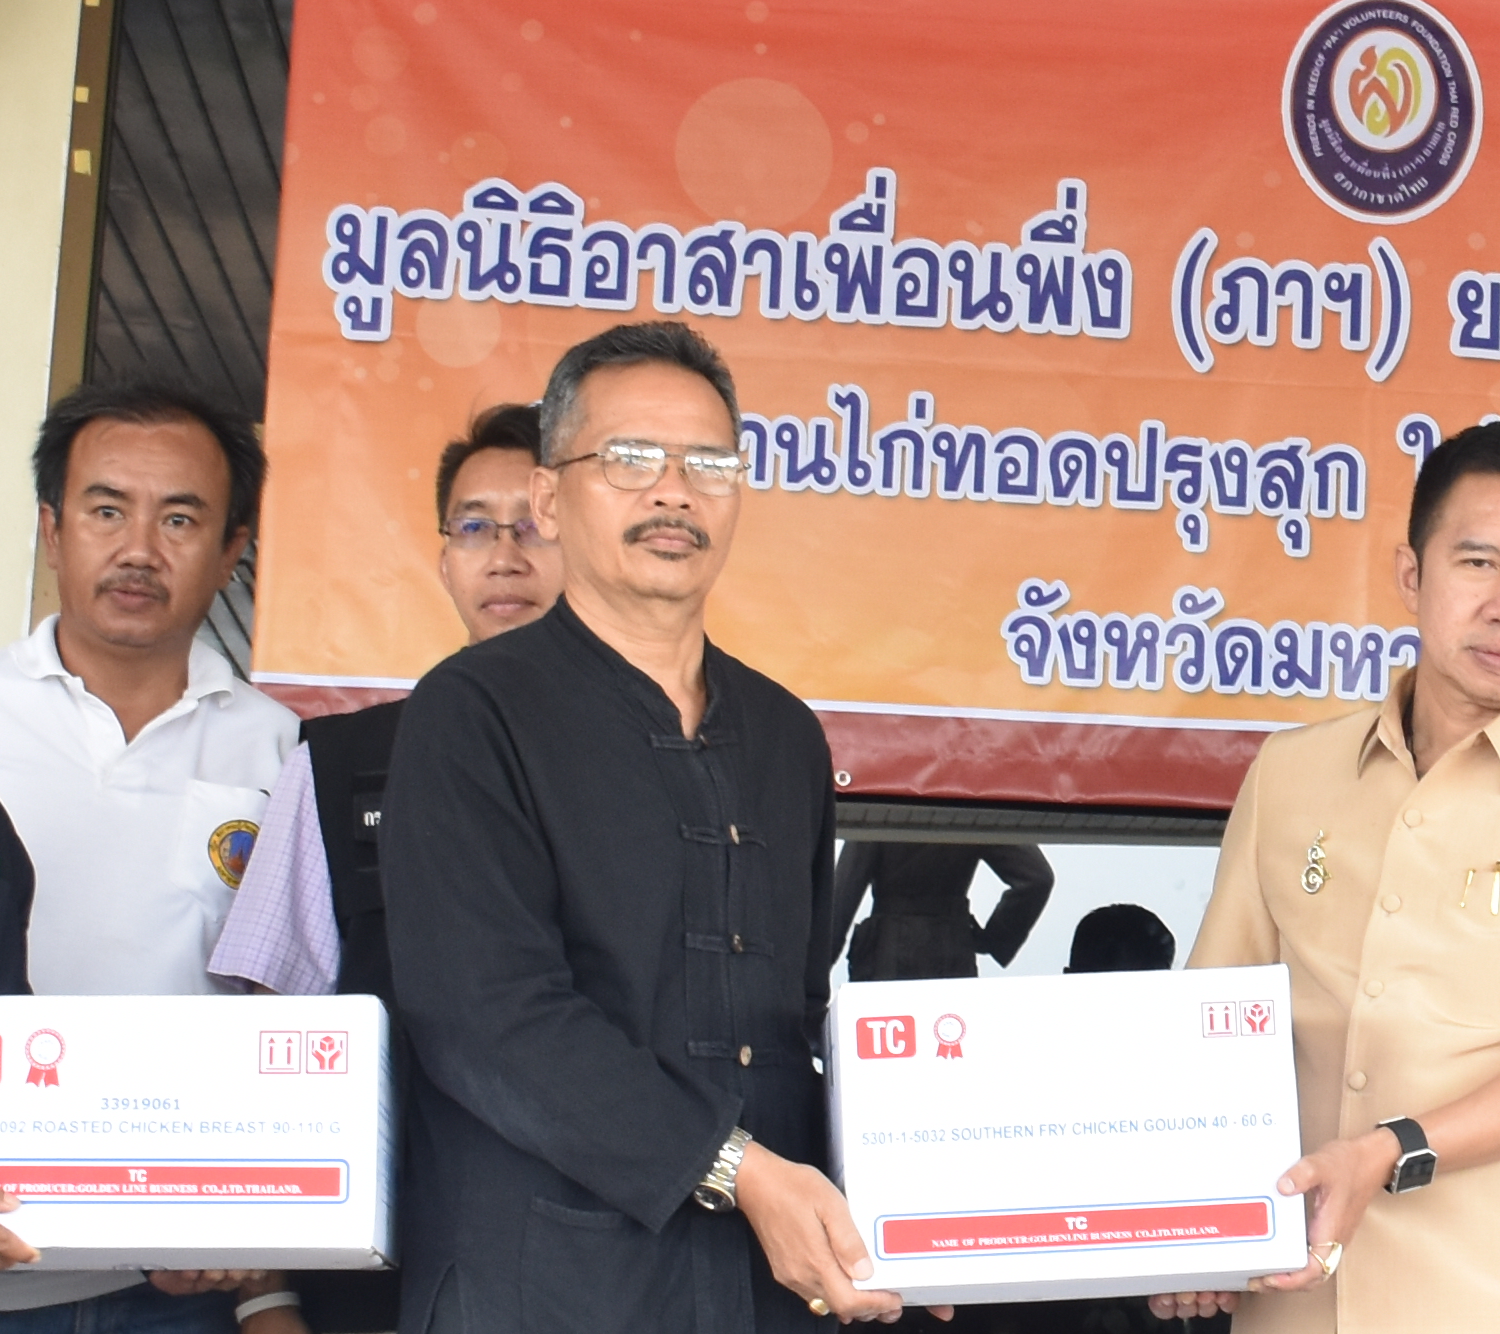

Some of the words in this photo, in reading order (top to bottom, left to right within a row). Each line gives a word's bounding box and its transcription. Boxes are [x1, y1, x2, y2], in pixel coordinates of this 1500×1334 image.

[1343, 8, 1410, 31] VOLUNTEERS
[1411, 20, 1454, 79] FOUNDATION
[1447, 80, 1460, 104] THAI
[1306, 100, 1316, 111] IN
[1449, 106, 1460, 129] RED
[1306, 114, 1324, 158] FRIENDS
[1438, 131, 1458, 167] CROSS
[1333, 171, 1430, 205] สภากาชาดไทย
[327, 175, 1125, 334] มูลนิธิอาสาเพื่อนพึ่ง
[1178, 234, 1404, 373] (ภาฯ)
[740, 389, 1361, 552] านไก่ทอดปรุงสุก
[865, 1018, 906, 1056] TC
[100, 1097, 180, 1110] 33919061
[32, 1120, 113, 1134] ROASTED
[119, 1120, 193, 1134] CHICKEN
[199, 1121, 266, 1134] BREAST
[272, 1121, 323, 1134] 90-110
[329, 1121, 341, 1134] G
[862, 1129, 946, 1145] 5301-1-5032
[951, 1125, 1034, 1142] SOUTHERN
[1039, 1123, 1067, 1137] FRY
[1072, 1119, 1139, 1136] CHICKEN
[1144, 1116, 1207, 1132] GOUJON
[1212, 1115, 1228, 1129] 40
[1241, 1113, 1257, 1127] 60
[128, 1169, 148, 1183] TC
[3, 1183, 18, 1193] OF
[122, 1183, 148, 1194] LINE
[148, 1184, 199, 1194] BUSINESS
[1064, 1216, 1089, 1231] TC
[931, 1238, 960, 1248] NAME
[961, 1238, 976, 1247] OF
[1089, 1229, 1133, 1241] BUSINESS
